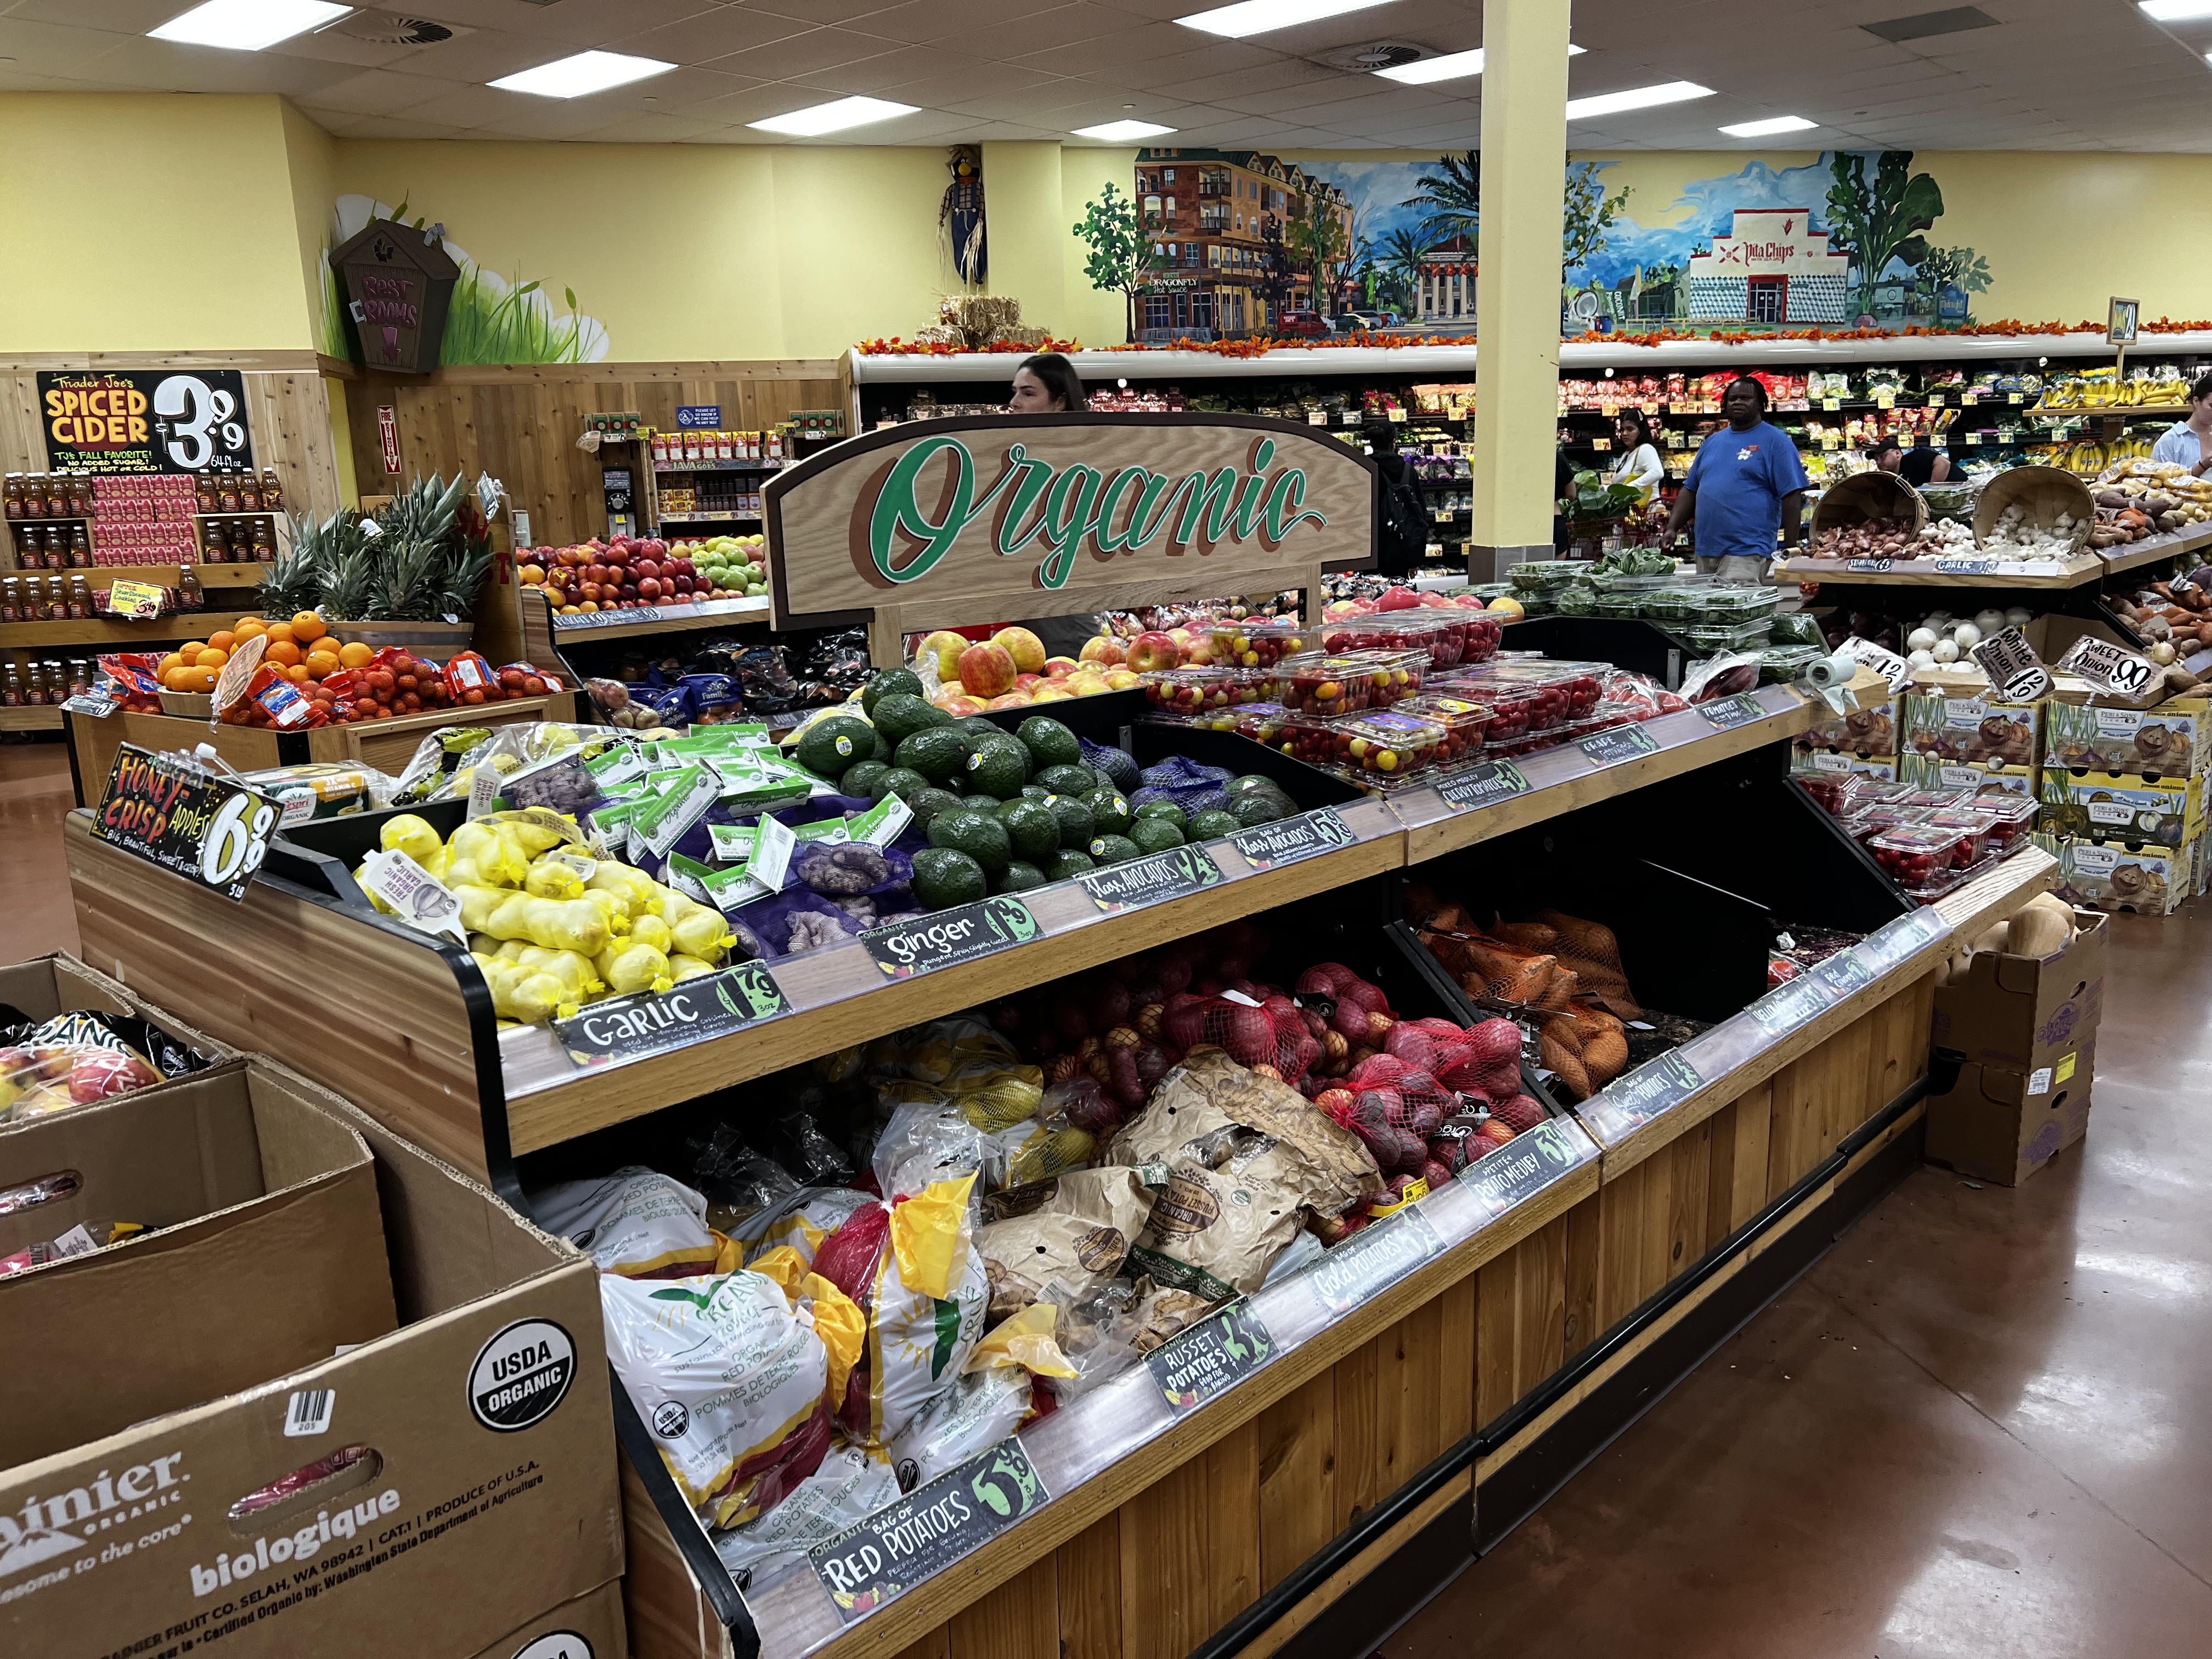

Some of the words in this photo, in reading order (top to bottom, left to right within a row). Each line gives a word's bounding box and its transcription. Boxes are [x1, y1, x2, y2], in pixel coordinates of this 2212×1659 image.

[1743, 241, 1764, 267] Pita
[1766, 242, 1794, 264] Chips
[1153, 286, 1165, 294] Hot
[364, 300, 417, 328] ROOMS
[1615, 291, 1625, 320] COCONUT
[52, 376, 99, 389] Trader
[104, 374, 133, 388] Joe's
[46, 390, 147, 416] SPICED
[381, 412, 392, 421] FIRE
[52, 416, 149, 443] CIDER
[105, 450, 153, 459] FAVORITE!
[385, 422, 395, 466] EXTINGUISHER
[673, 461, 696, 470] JAVA
[868, 435, 1329, 590] Organic
[1938, 561, 1972, 569] GARLIC
[1985, 639, 2013, 673] Onion
[2001, 628, 2032, 665] White
[2084, 638, 2127, 661] SWEET
[2074, 651, 2114, 675] Onion
[1702, 700, 1738, 716] TOMATOES
[1583, 736, 1616, 752] GRAPE
[478, 780, 488, 808] ORGANIC
[1436, 780, 1457, 790] MIXED
[1458, 774, 1479, 785] MEDLEY
[1442, 786, 1473, 802] CHERRY
[1470, 776, 1506, 797] TOMATOES
[105, 796, 167, 843] CRISP
[168, 804, 210, 840] APPLES
[282, 812, 309, 821] ORGANIC
[653, 798, 679, 823] Christopher
[665, 794, 690, 824] Organic
[1236, 837, 1269, 855] Hass
[1267, 825, 1315, 852] AVOCADOS
[384, 867, 415, 893] ORGANIC
[397, 865, 422, 887] GARLIC
[1085, 877, 1126, 898] Hass
[1120, 859, 1179, 891] AVOCADOS
[385, 881, 408, 900] FRESH
[864, 923, 907, 939] ORGANIC
[887, 918, 975, 963] ginger
[1612, 1088, 1641, 1113] Sweet
[1635, 1073, 1671, 1101] POTATOES
[1626, 1079, 1638, 1088] BAG
[1474, 1170, 1511, 1199] POTATO
[1503, 1153, 1541, 1185] MEDLEY
[1486, 1156, 1509, 1175] PETITE
[1160, 1203, 1193, 1222] ORGANIC
[1189, 1199, 1215, 1215] RUSSET
[1314, 1261, 1357, 1296] Gold
[1351, 1233, 1402, 1276] POTATOES
[1335, 1251, 1348, 1261] BAG
[1348, 1245, 1357, 1255] OF
[491, 1340, 552, 1381] USDA
[1164, 1331, 1215, 1370] RUSSET
[694, 1386, 748, 1419] POMMES
[748, 1375, 763, 1392] DE
[764, 1355, 789, 1383] TERRE
[788, 1331, 811, 1363] ROUGES
[721, 1365, 746, 1383] RED
[1166, 1348, 1227, 1392] POTATOES
[1198, 1373, 1213, 1387] GOOD
[1212, 1367, 1224, 1378] FOR
[487, 1367, 562, 1412] ORGANIC
[742, 1362, 800, 1408] BIOLOGIQUES
[298, 1423, 316, 1431] 205
[658, 1408, 679, 1425] USDA
[83, 1491, 182, 1536] ORGANIC
[765, 1526, 786, 1545] RED
[785, 1486, 824, 1527] POTATOES
[771, 1487, 807, 1528] ORGANIC
[872, 1517, 897, 1536] BAG
[898, 1505, 914, 1520] OF
[165, 1613, 208, 1642] FRUIT
[212, 1601, 238, 1622] CO.
[240, 1579, 291, 1609] SELAH,
[293, 1568, 319, 1585] WA
[320, 1545, 364, 1571] 98942
[426, 1487, 486, 1523] PRODUCE
[487, 1478, 504, 1491] OF
[505, 1460, 540, 1482] U.S.A.
[189, 1488, 401, 1598] biologique
[815, 1520, 870, 1558] ORGANIC
[821, 1545, 882, 1593] RED
[882, 1490, 972, 1561] POTATOES
[75, 1555, 97, 1573] to
[100, 1539, 133, 1564] the
[204, 1613, 255, 1644] Certified
[257, 1592, 303, 1621] Organic
[304, 1583, 323, 1600] by:
[324, 1552, 389, 1590] Washington
[390, 1537, 418, 1558] State
[420, 1505, 478, 1544] Department
[479, 1500, 490, 1513] of
[492, 1474, 544, 1506] Agriculture
